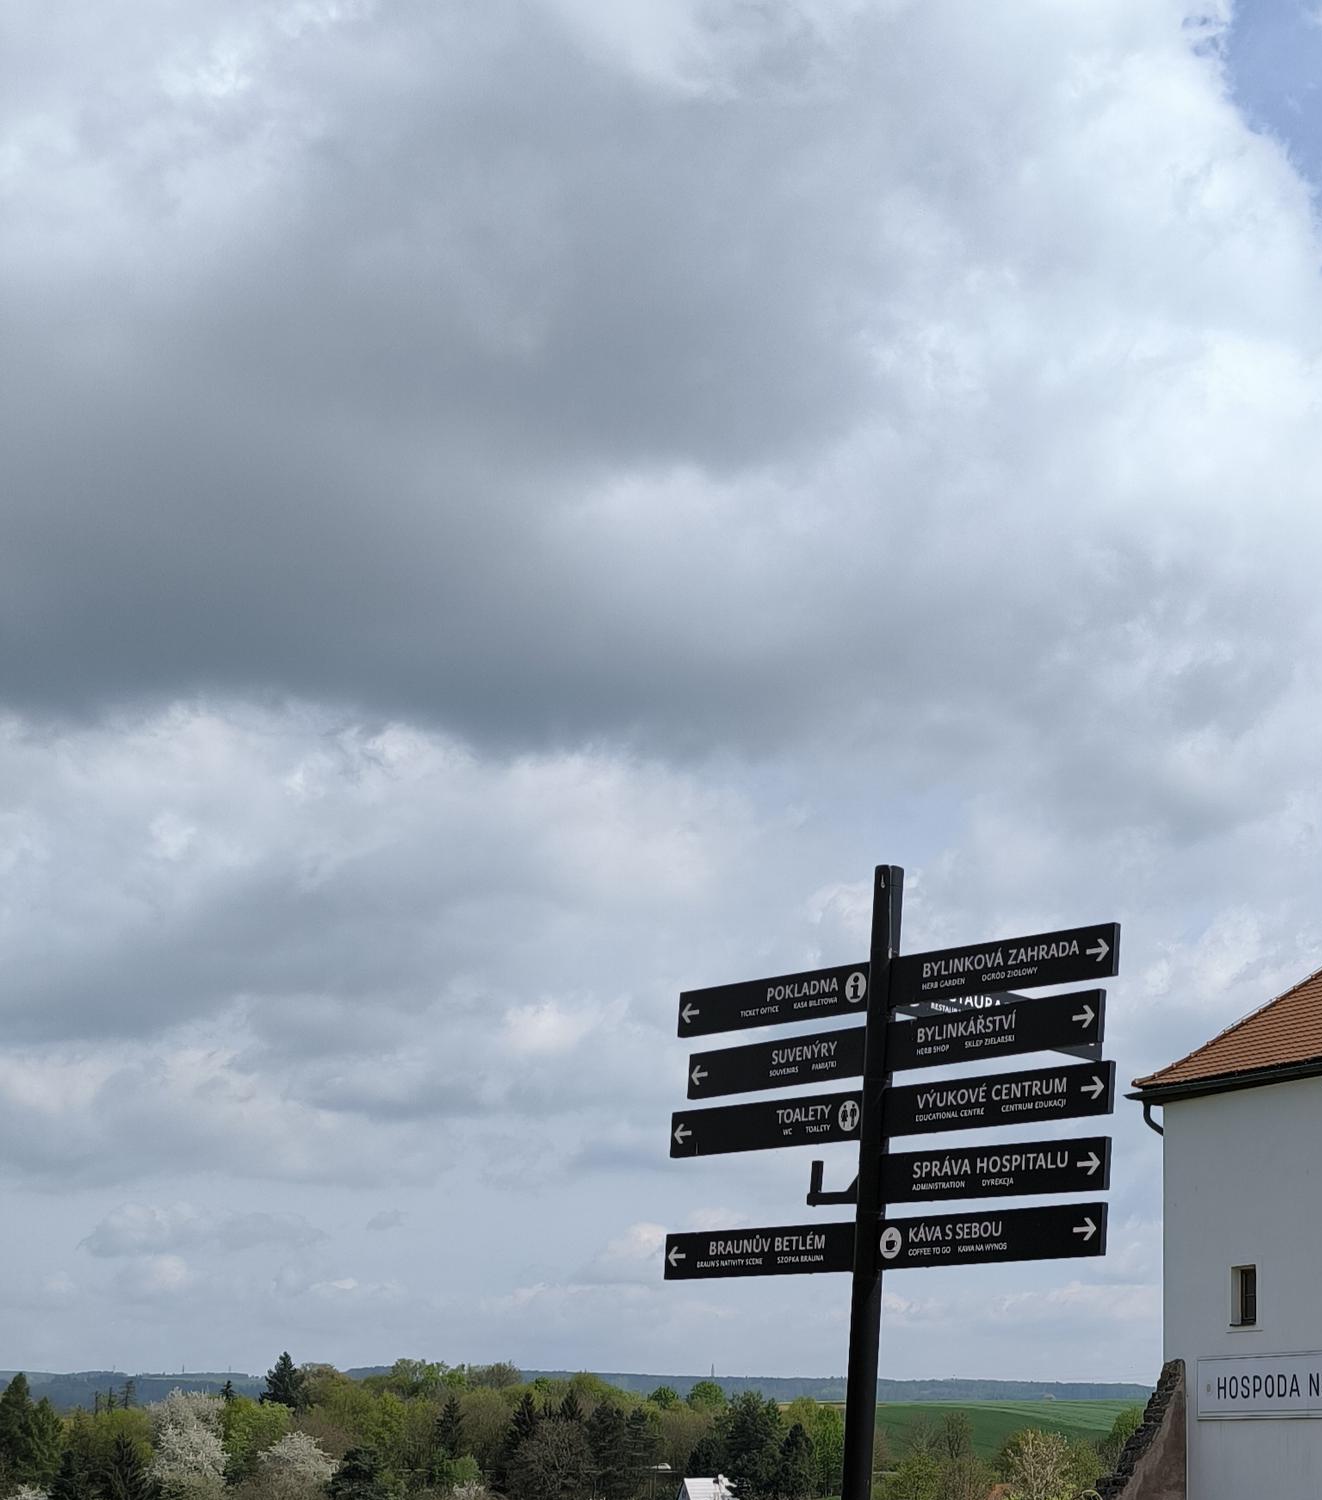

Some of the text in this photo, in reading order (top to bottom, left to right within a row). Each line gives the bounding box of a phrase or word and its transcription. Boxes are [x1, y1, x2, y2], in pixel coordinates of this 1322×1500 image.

[922, 940, 1080, 978] BYLINKOVÁ ZAHRADA
[981, 971, 1005, 982] OGRÓD
[766, 977, 839, 1001] POKLADNA
[921, 978, 965, 990] HERB GARDEN
[740, 1008, 759, 1018] TICKET
[917, 1009, 1016, 1043] BYLINKÁŘSTVÍ
[933, 1044, 949, 1053] SHOP
[964, 1039, 983, 1048] SKLEP
[771, 1040, 837, 1065] SUVENÝRY
[769, 1065, 798, 1077] SOUVENIRS
[917, 1077, 1067, 1109] VÝUKOVÉ CENTRUM
[1001, 1099, 1066, 1113] CENTRUM EDUKACJI
[776, 1104, 832, 1124] TOALETY
[915, 1107, 985, 1122] EDUCATIONAL CENTRE
[783, 1127, 792, 1136] WC
[805, 1124, 831, 1134] TOALETY
[912, 1151, 1069, 1179] SPRÁVA HOSPITALU
[912, 1180, 965, 1191] ADMINISTRATION
[908, 1221, 1002, 1243] KÁVA S SEBOU
[709, 1231, 826, 1256] BRAUNŮV BETLÉM
[957, 1242, 1007, 1253] KAWA NA WYNOS
[908, 1246, 951, 1257] COFFEE TO GO
[720, 1258, 744, 1267] NATIVITY
[745, 1257, 763, 1266] SCENE
[777, 1256, 799, 1264] SZOPKA
[1217, 1373, 1300, 1400] HOSPODA
